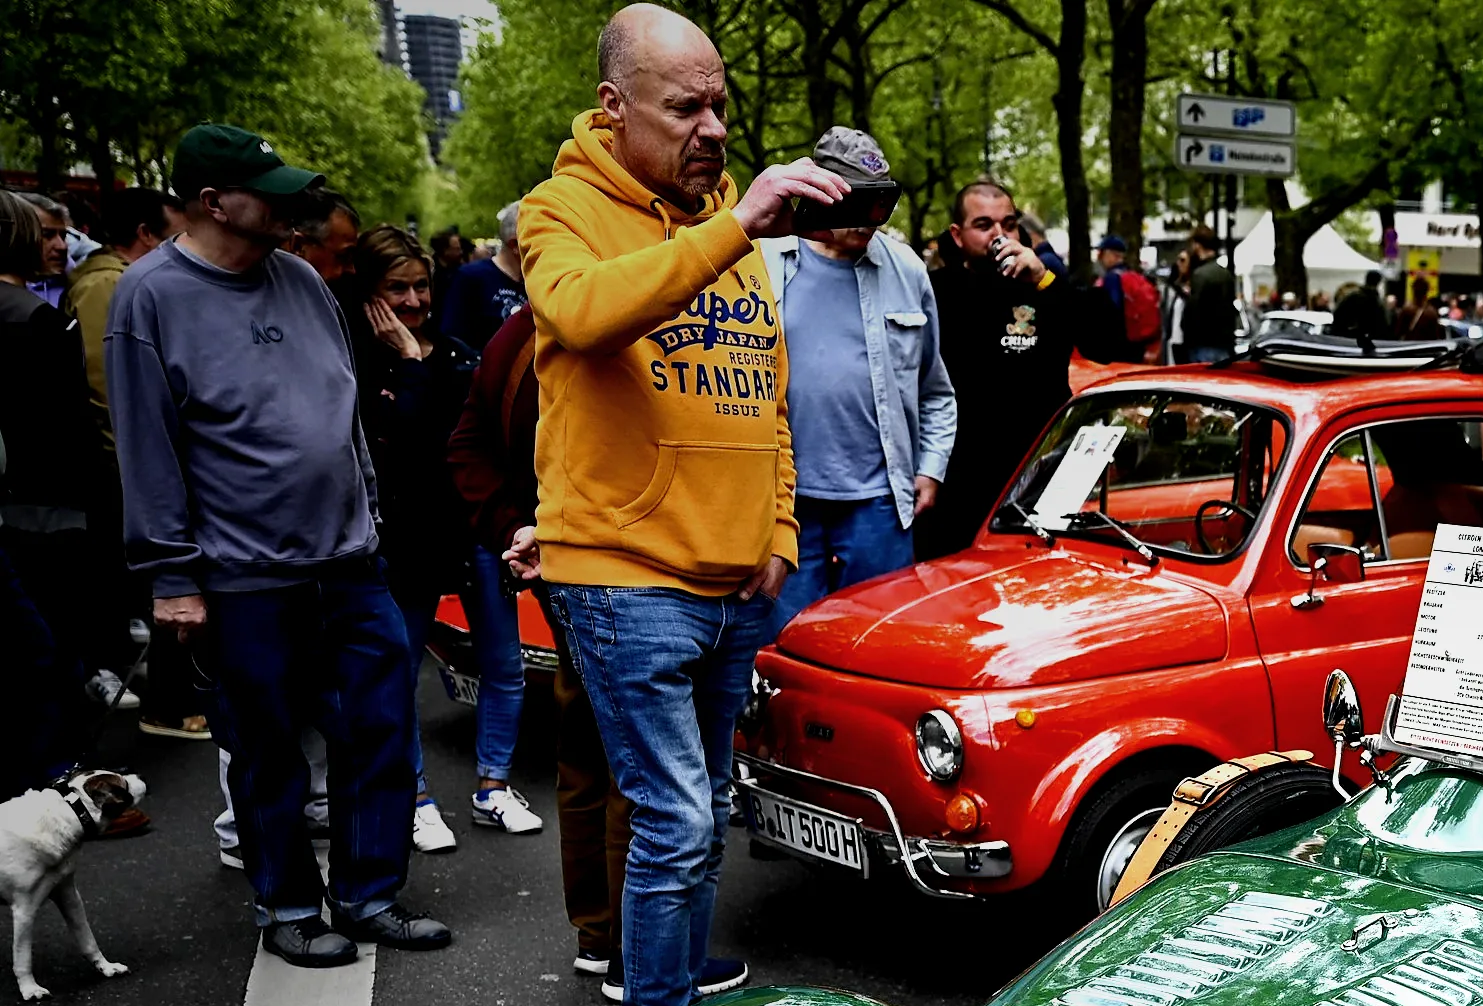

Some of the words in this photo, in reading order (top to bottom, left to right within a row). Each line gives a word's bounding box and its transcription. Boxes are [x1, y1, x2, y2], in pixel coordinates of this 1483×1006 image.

[671, 291, 776, 347] uper
[661, 326, 705, 349] DRY
[650, 360, 777, 402] STANDAR
[715, 402, 760, 418] ISSUE
